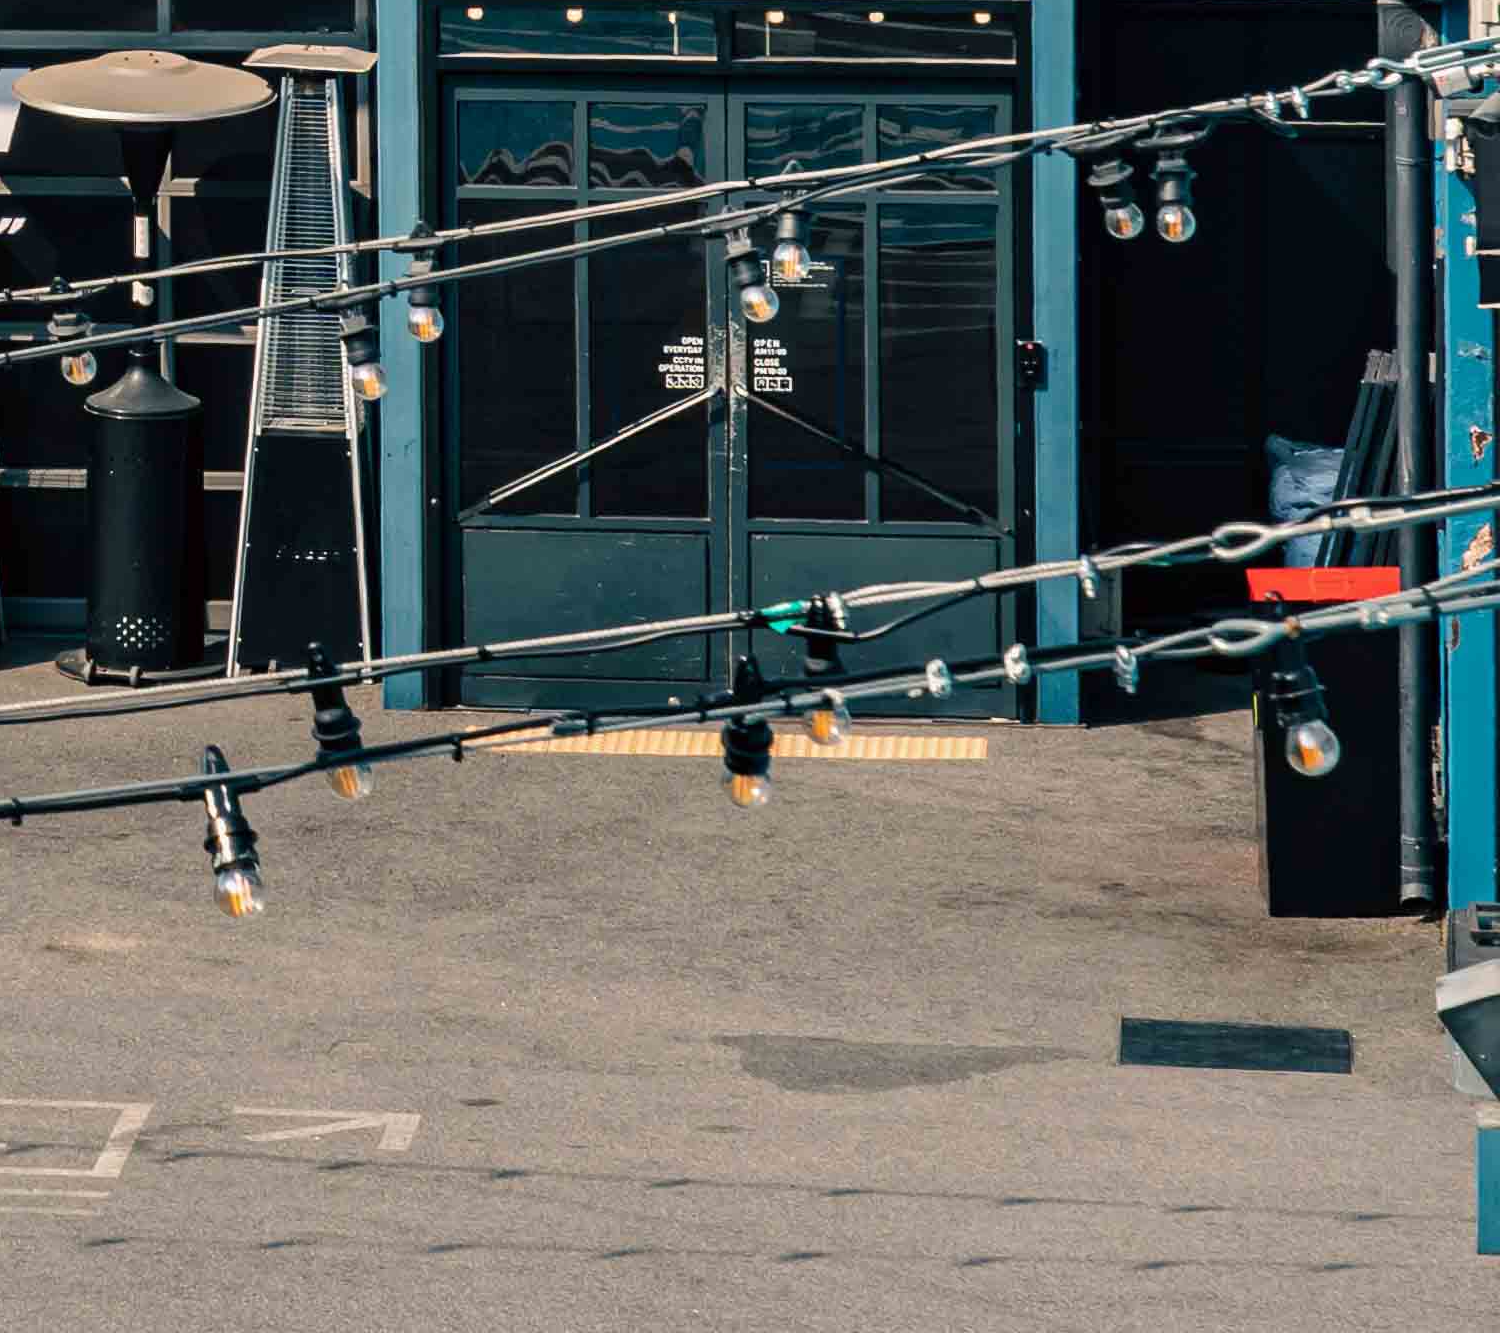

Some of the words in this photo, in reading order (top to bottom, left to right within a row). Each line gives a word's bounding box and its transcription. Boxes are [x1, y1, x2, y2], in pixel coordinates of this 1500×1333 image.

[681, 336, 704, 346] OPEN
[753, 339, 781, 348] OPEN
[663, 345, 703, 354] EVERYDAY
[672, 356, 693, 365] CCTV
[753, 358, 780, 367] CLOSE
[658, 364, 705, 373] OPERATION
